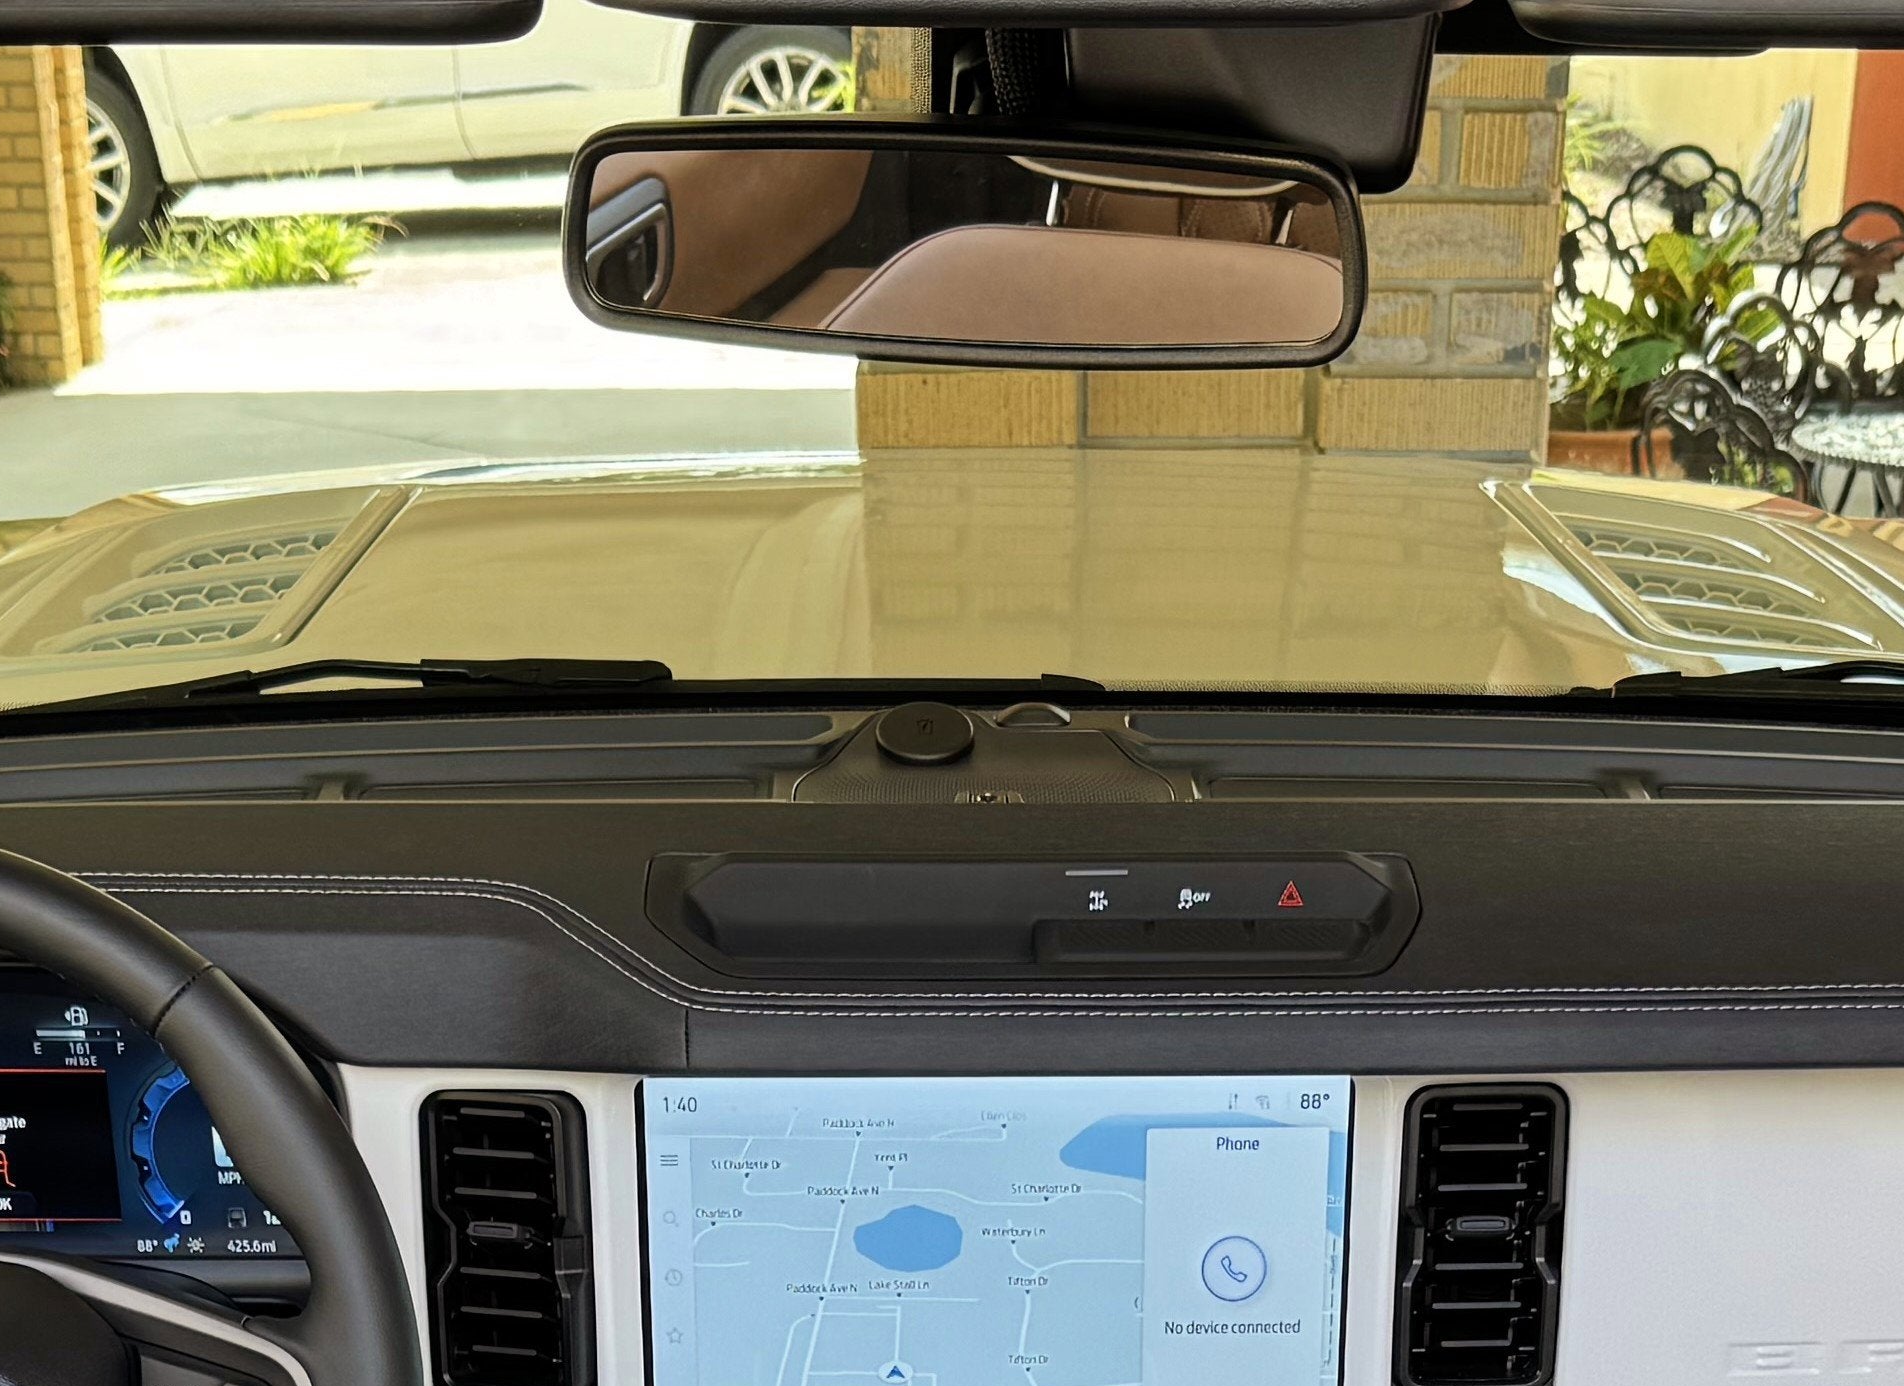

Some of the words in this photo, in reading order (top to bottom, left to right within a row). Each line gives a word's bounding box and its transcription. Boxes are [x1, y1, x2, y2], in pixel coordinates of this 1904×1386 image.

[33, 1042, 42, 1055] E
[116, 1042, 125, 1055] F
[663, 1095, 698, 1113] 1:40
[1299, 1093, 1331, 1110] 88°
[1216, 1136, 1260, 1152] Phone
[695, 1208, 731, 1219] Charles
[732, 1208, 744, 1218] Dr
[868, 1280, 892, 1291] Lake
[1164, 1321, 1184, 1335] No
[1186, 1320, 1229, 1335] device
[1231, 1319, 1302, 1335] connected
